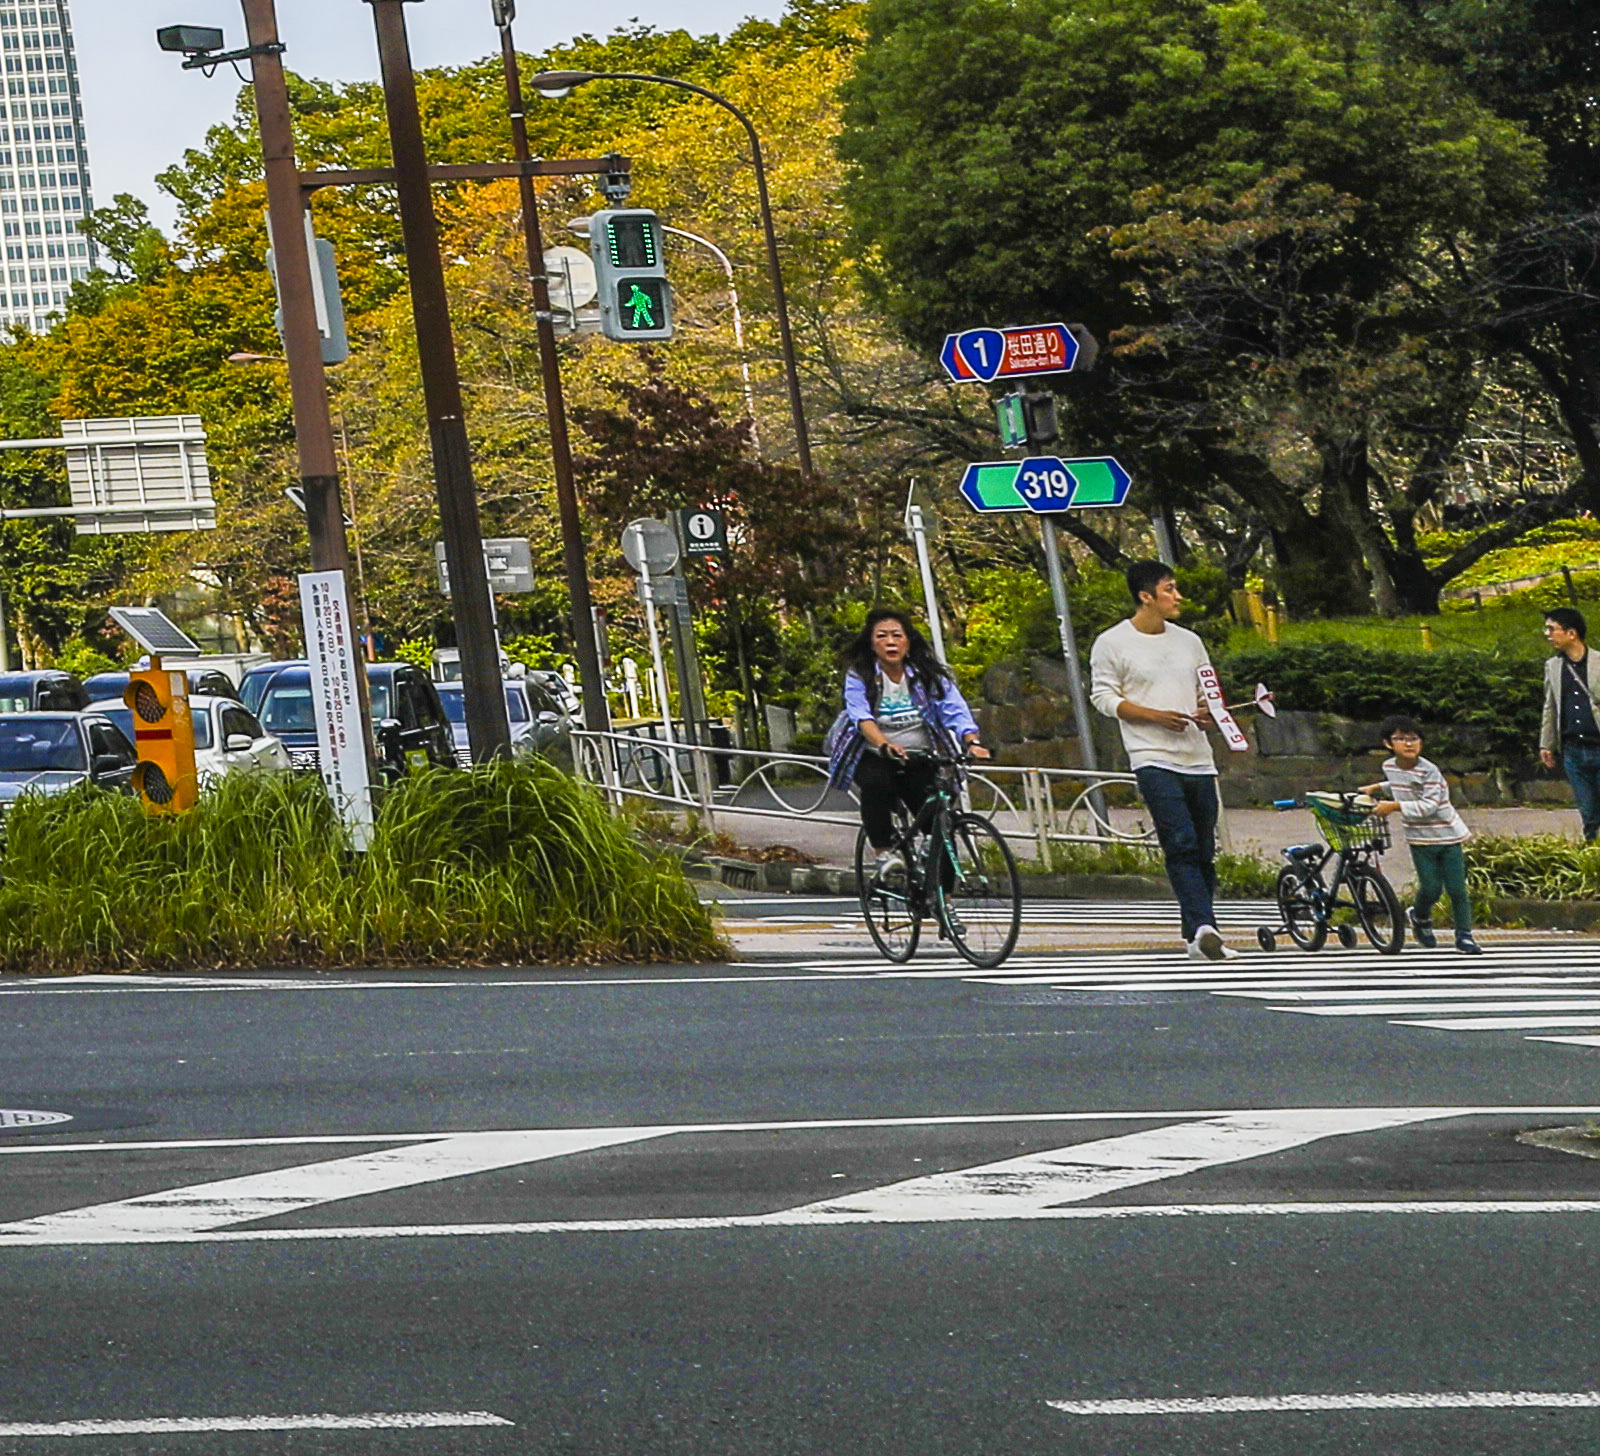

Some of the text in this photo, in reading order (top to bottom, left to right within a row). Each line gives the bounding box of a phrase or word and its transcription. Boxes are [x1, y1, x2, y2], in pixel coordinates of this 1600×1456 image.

[973, 337, 988, 367] 1
[1007, 332, 1059, 357] 桜田通り
[1023, 470, 1069, 499] 319
